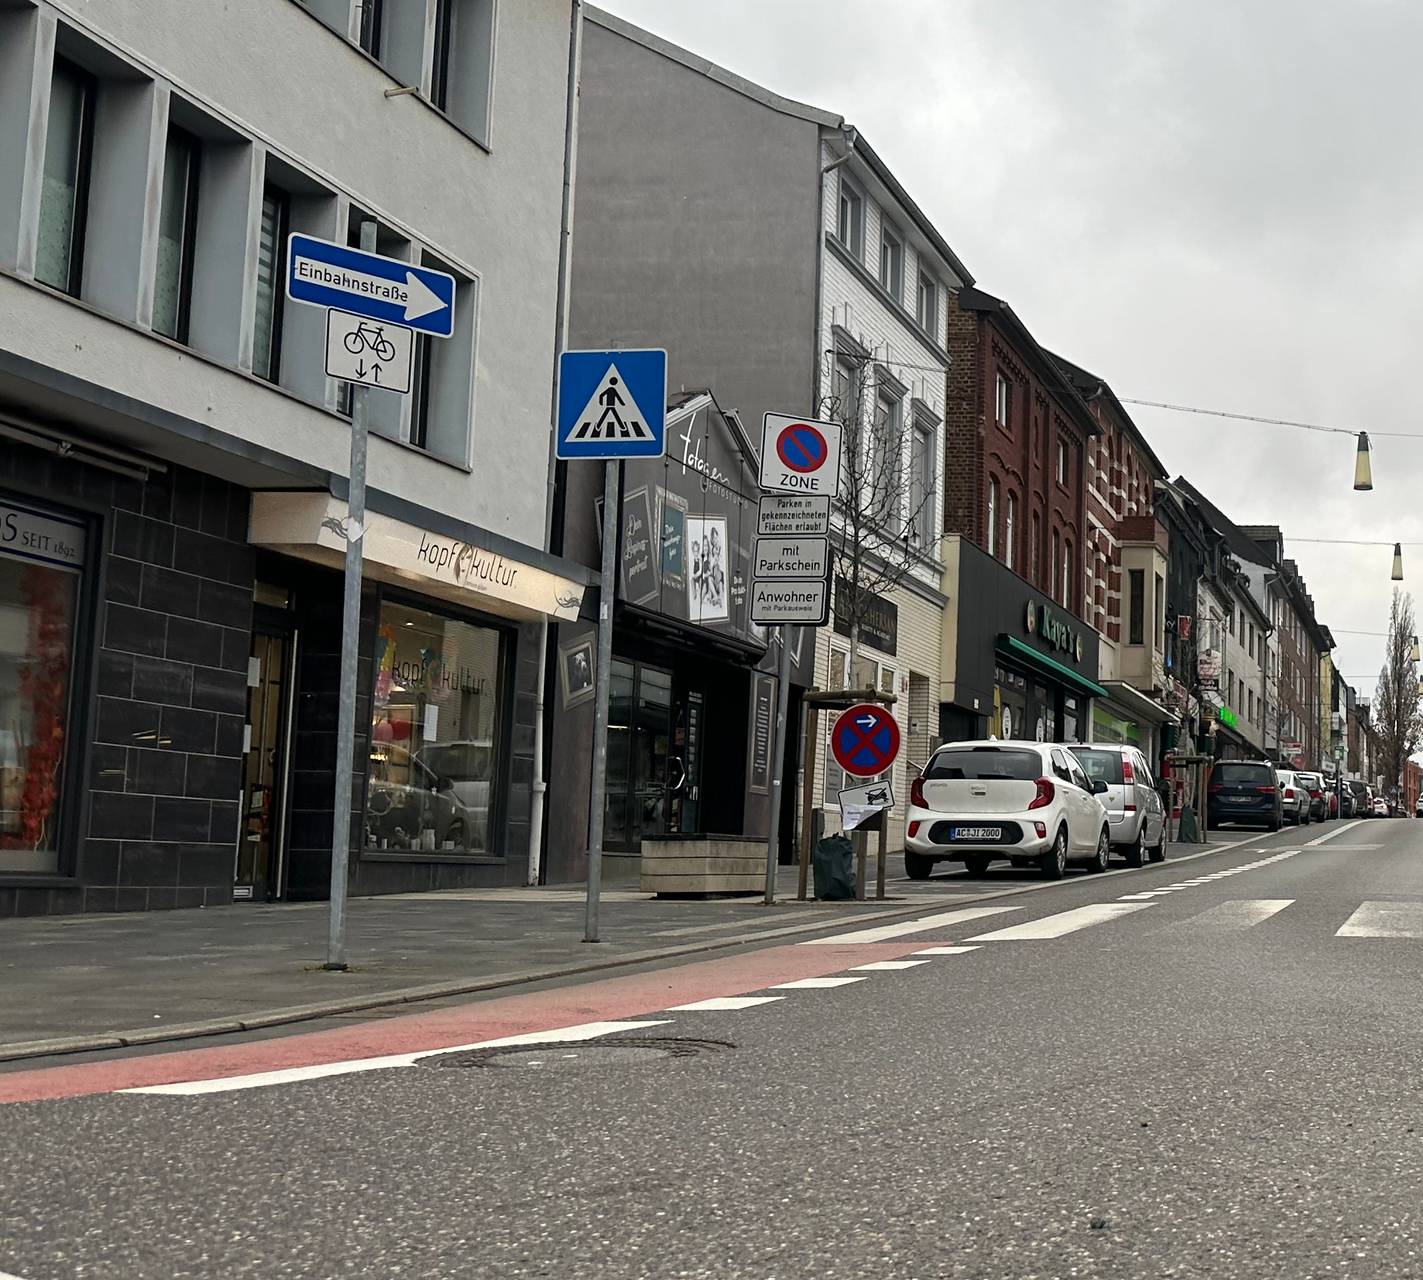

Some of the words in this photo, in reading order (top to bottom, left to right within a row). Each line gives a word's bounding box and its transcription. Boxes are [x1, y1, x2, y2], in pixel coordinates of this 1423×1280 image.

[299, 261, 408, 302] Einbahnstraße
[780, 473, 820, 491] ZONE
[777, 499, 803, 509] Parken
[805, 500, 812, 509] in
[761, 510, 827, 522] gekennzeichneten
[764, 522, 793, 532] Flächen
[796, 522, 822, 532] erlaubt
[21, 531, 52, 551] SEIT
[417, 532, 460, 573] kopf
[782, 546, 800, 557] mit
[759, 559, 821, 572] Parkschein
[757, 591, 819, 603] Anwohner
[981, 828, 1000, 837] 2000
